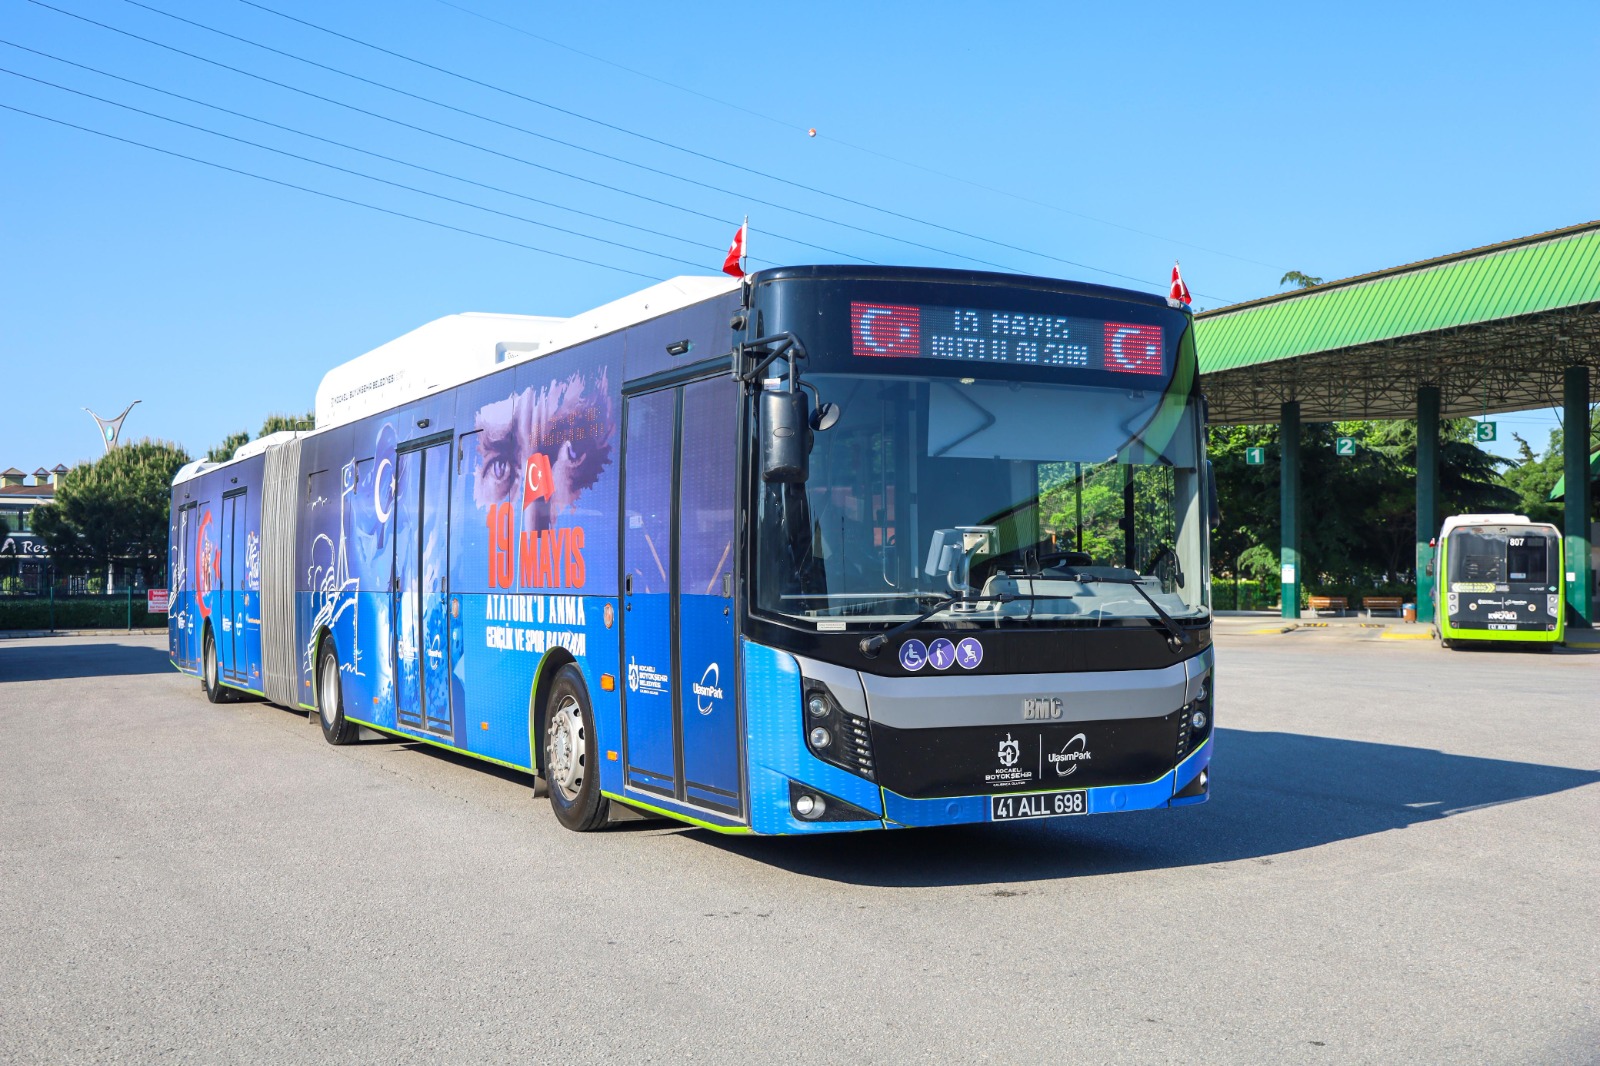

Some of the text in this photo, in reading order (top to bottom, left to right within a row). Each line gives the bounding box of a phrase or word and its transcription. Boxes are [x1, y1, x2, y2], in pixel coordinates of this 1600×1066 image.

[1480, 423, 1493, 439] 3
[1251, 449, 1260, 463] 1
[1340, 439, 1352, 453] 2
[486, 502, 586, 589] 19 MAYIS
[1509, 537, 1525, 547] 807
[549, 596, 586, 626] ANMA
[514, 628, 525, 651] VE
[525, 629, 545, 654] SPOR
[1024, 698, 1063, 720] BMC
[997, 793, 1083, 818] 41 ALL 698
